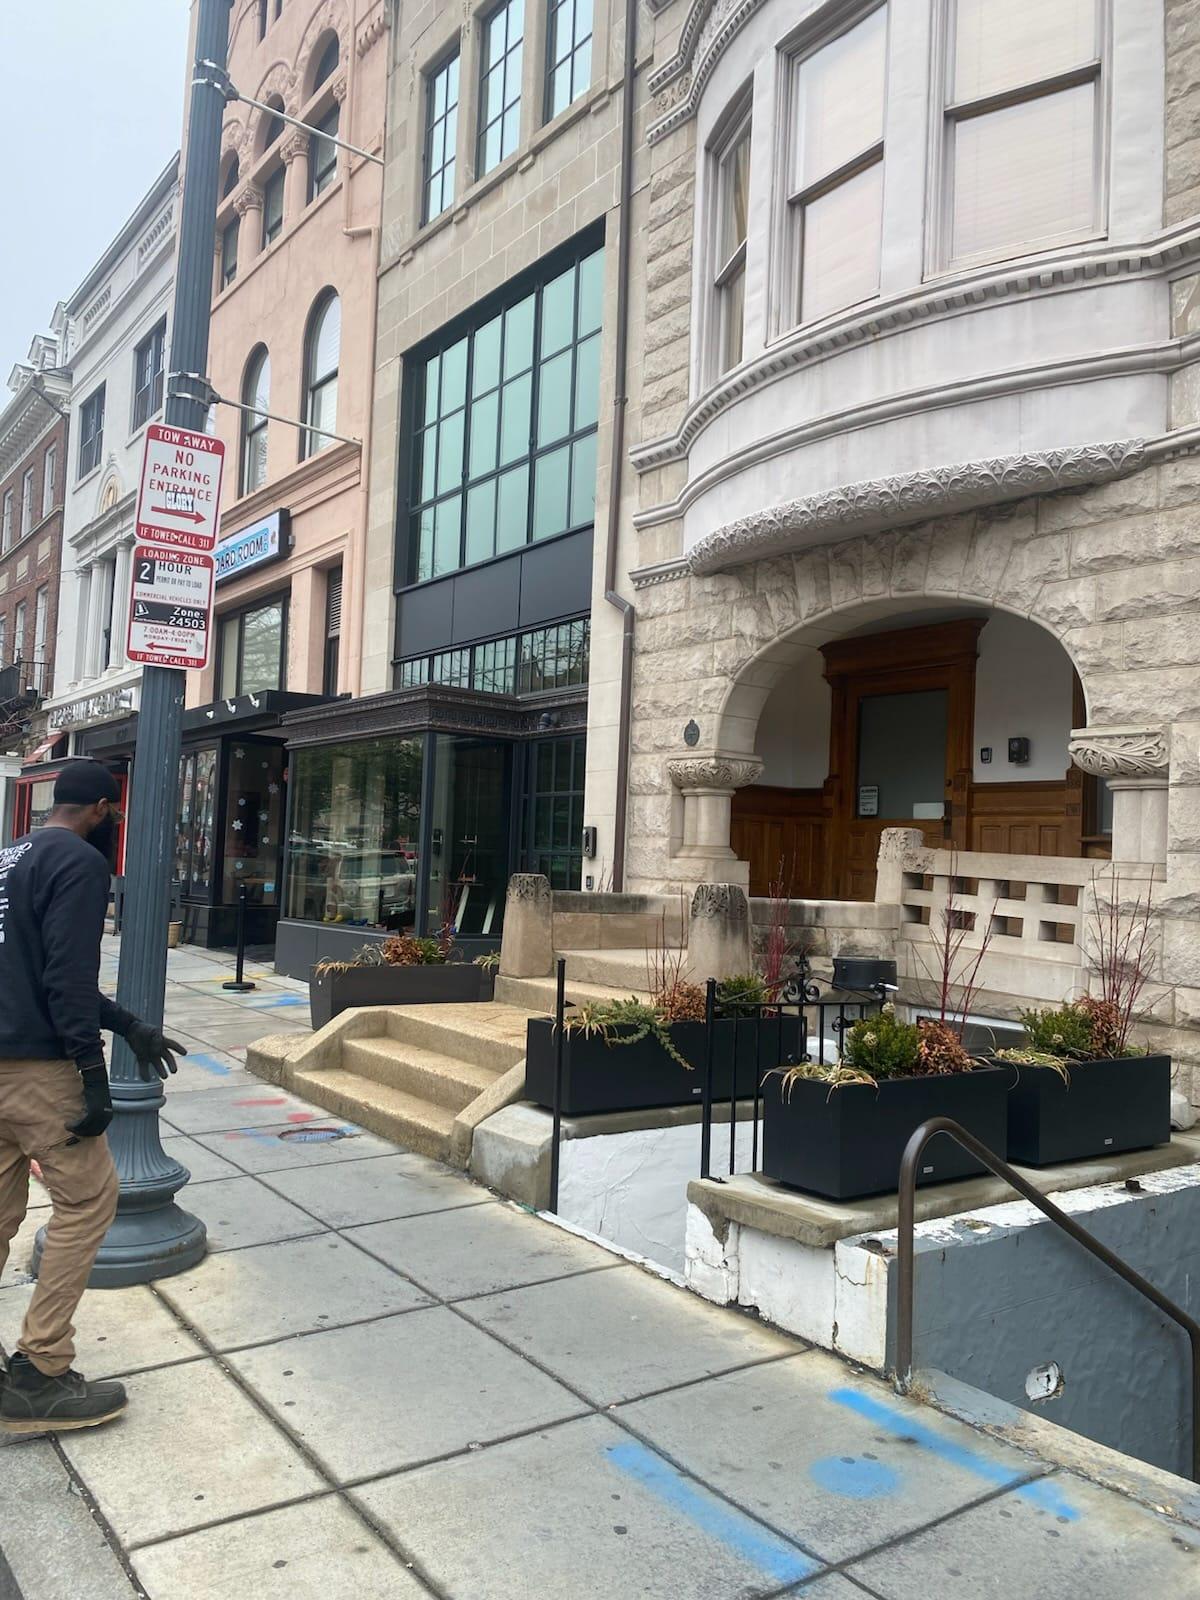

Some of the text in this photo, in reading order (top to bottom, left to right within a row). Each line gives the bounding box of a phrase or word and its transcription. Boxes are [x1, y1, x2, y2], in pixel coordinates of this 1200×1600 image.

[158, 429, 215, 451] TOW AWAY
[175, 450, 194, 466] NO
[153, 463, 210, 485] PARKING
[149, 479, 213, 501] ENTRANCE
[166, 491, 194, 512] GLORY
[140, 527, 149, 536] IF
[151, 528, 178, 540] TOWED
[179, 534, 197, 546] CALL
[199, 538, 210, 548] 311
[143, 548, 204, 566] LOADING ZONE
[215, 550, 236, 573] OARD
[238, 535, 263, 561] ROOM
[140, 561, 192, 580] 2 HOUR
[177, 579, 186, 587] PAY
[191, 581, 202, 589] LOAD
[136, 591, 167, 601] COMMERCIAL
[169, 595, 192, 604] VEHICLES
[173, 606, 204, 619] Zone:
[169, 616, 206, 630] 24503
[145, 653, 167, 662] TOWED
[169, 656, 185, 665] CALL
[187, 658, 198, 666] 311
